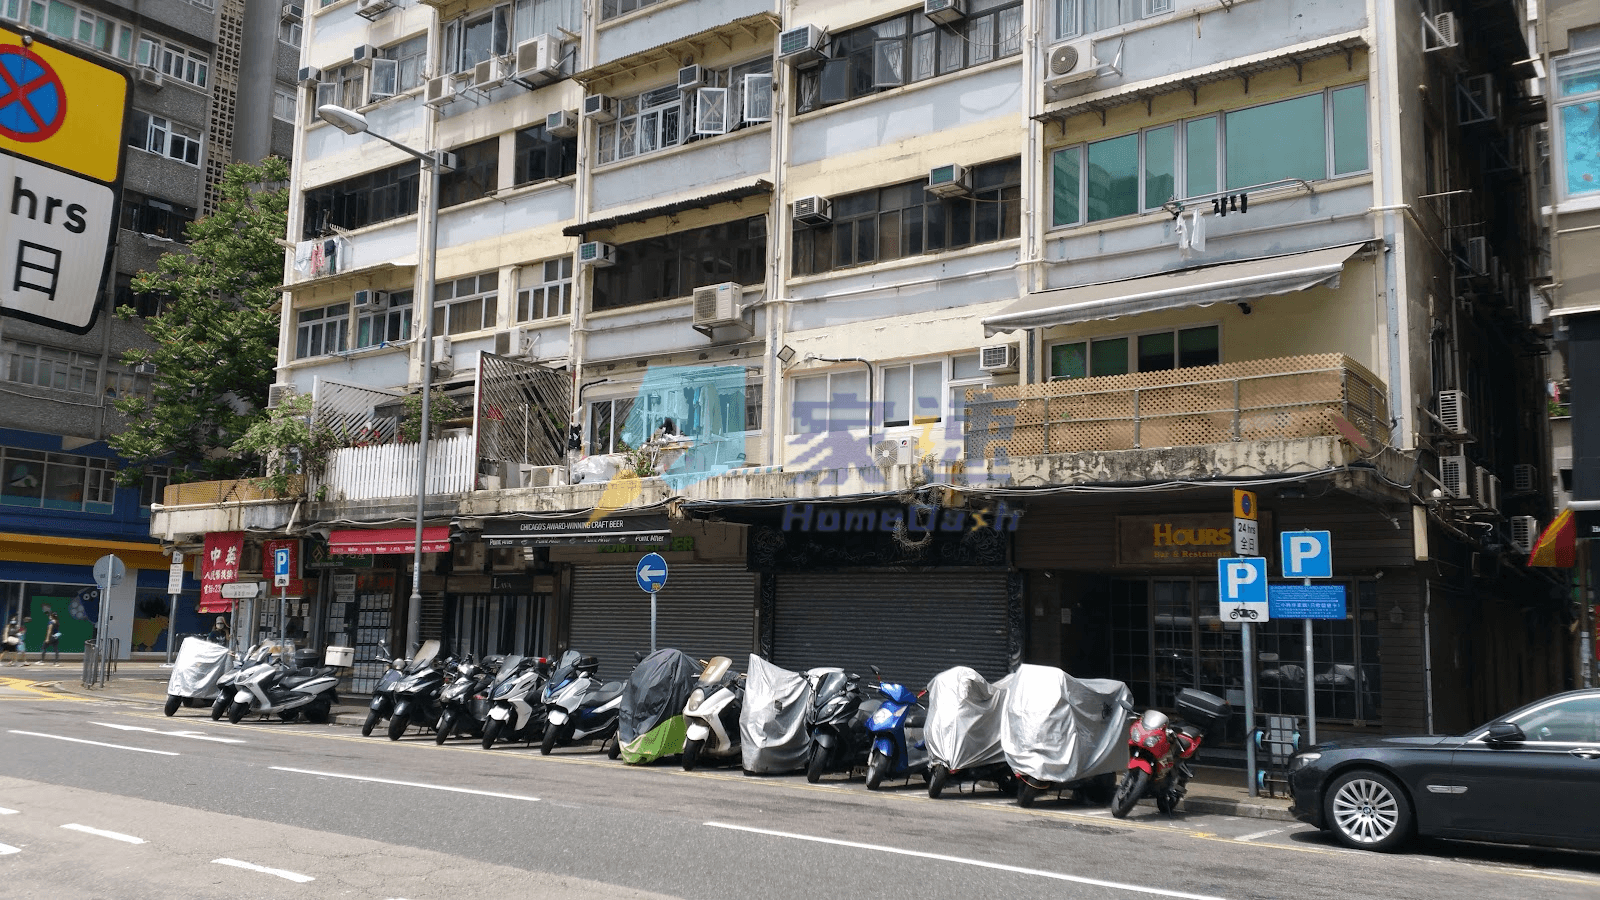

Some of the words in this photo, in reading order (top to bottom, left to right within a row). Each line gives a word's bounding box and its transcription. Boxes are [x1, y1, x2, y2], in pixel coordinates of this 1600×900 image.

[10, 176, 88, 234] hrs
[13, 239, 62, 302] 日
[520, 523, 546, 531] CHICAGO'S
[546, 521, 590, 531] AWARD-WINNING
[591, 521, 609, 529] CRAFT
[609, 520, 623, 528] BEER
[1238, 522, 1246, 533] 24
[1247, 524, 1256, 535] hrs
[1240, 537, 1255, 551] 全日
[1290, 536, 1322, 573] P
[210, 546, 237, 567] 中英
[277, 551, 287, 573] P
[1227, 563, 1258, 598] P
